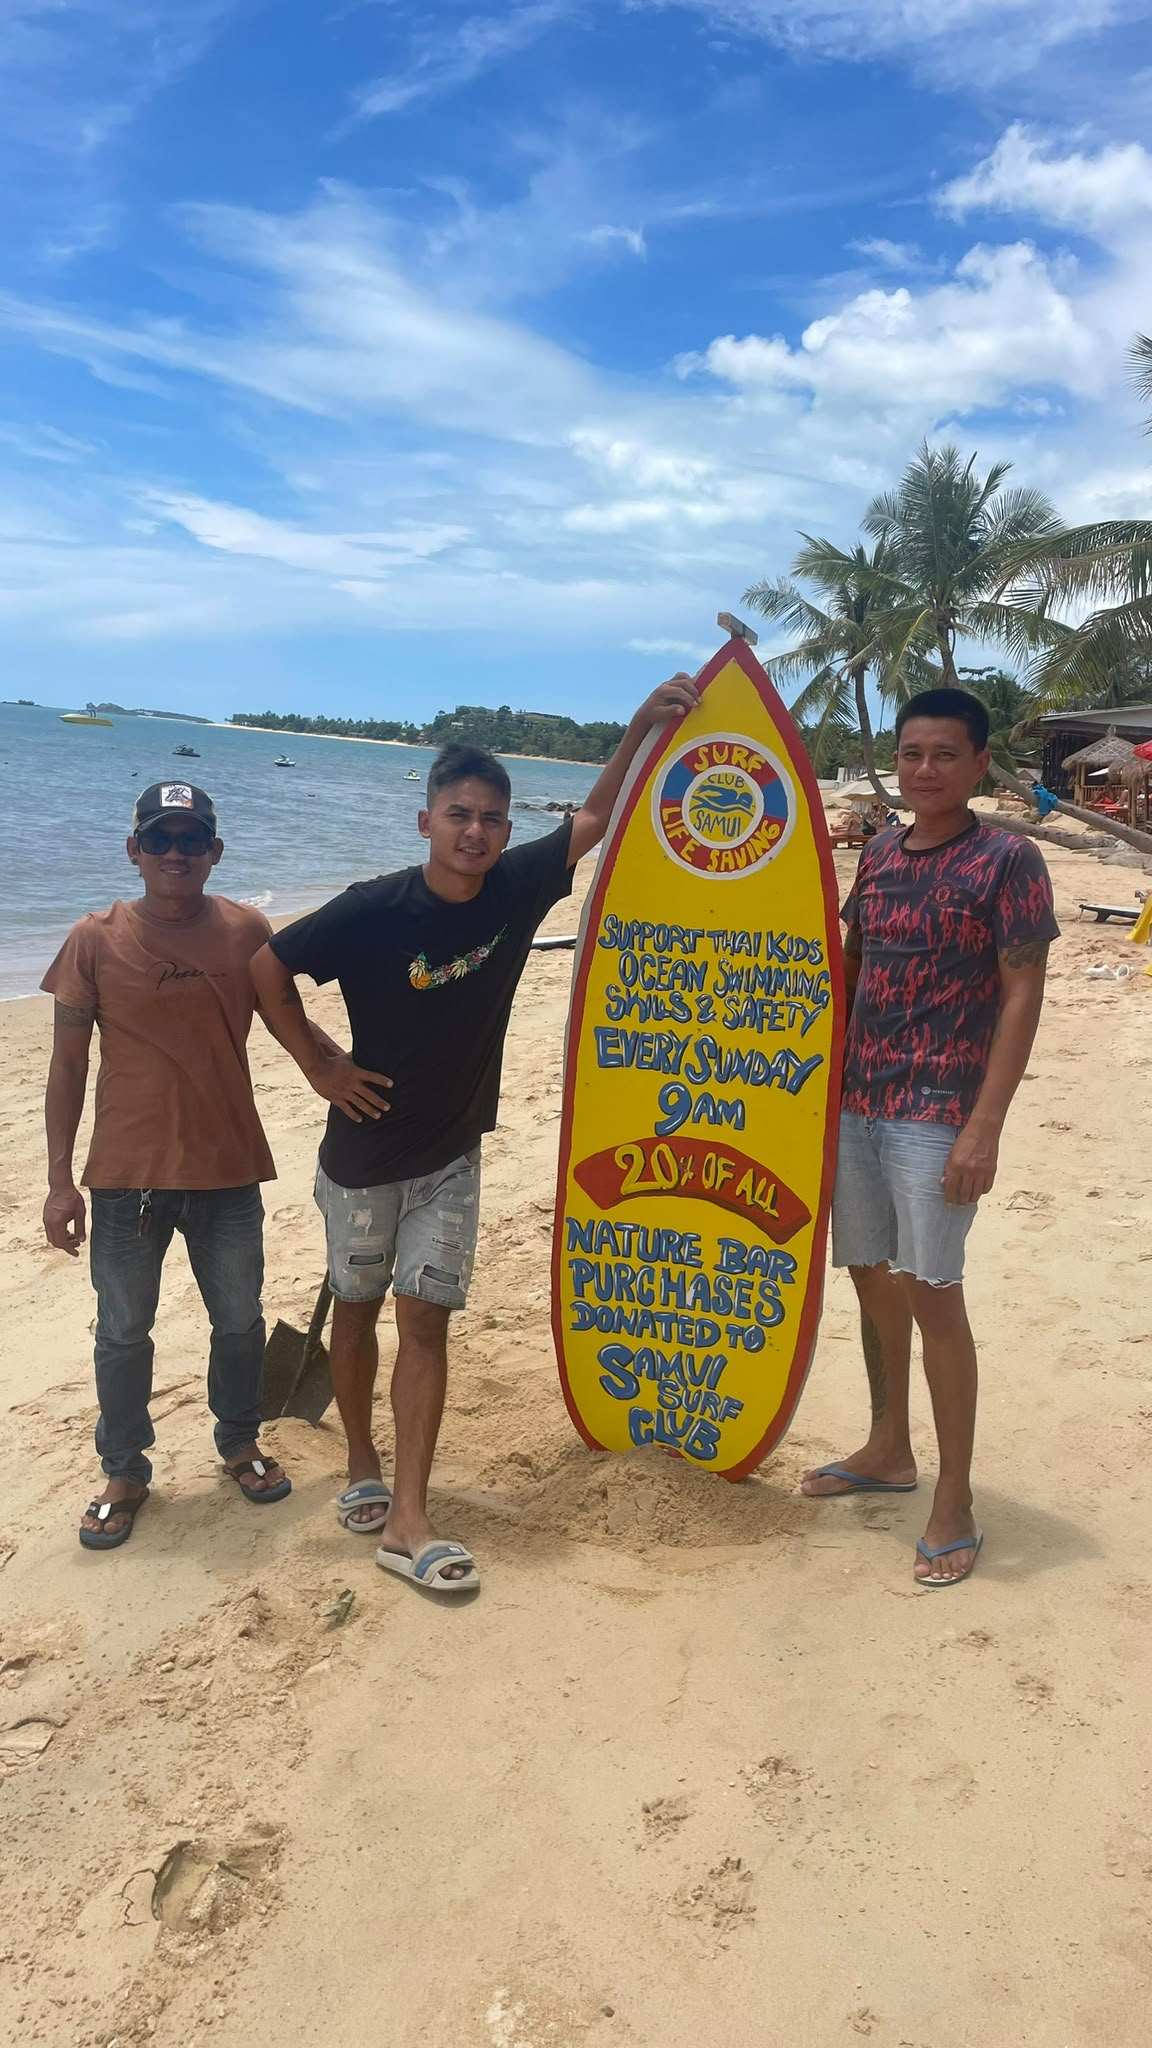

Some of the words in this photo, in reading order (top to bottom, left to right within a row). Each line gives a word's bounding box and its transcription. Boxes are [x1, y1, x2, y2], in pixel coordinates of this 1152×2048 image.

[694, 744, 766, 772] SURF
[708, 773, 745, 787] CLUB
[662, 806, 700, 862] LIFE
[707, 820, 780, 872] SAVING
[694, 810, 741, 837] SAMUI
[598, 914, 704, 954] SUPPORT
[707, 929, 761, 957] THAI
[767, 930, 824, 965] KIDS
[619, 950, 708, 991] OCEAN
[713, 958, 831, 1009] SWIMMING
[696, 994, 716, 1024] &
[723, 995, 823, 1038] SAFETY
[594, 1026, 693, 1075] EVERY
[685, 1034, 824, 1095] SUNDAY
[615, 1143, 695, 1195] 20%
[702, 1152, 735, 1190] OF
[736, 1168, 780, 1218] ALL
[566, 1216, 703, 1268] NATURE
[713, 1238, 797, 1284] BAR
[568, 1258, 785, 1327] PURCHASES
[570, 1300, 721, 1348] DONATED
[725, 1323, 766, 1352] TO
[597, 1343, 728, 1400] SAMUI
[657, 1379, 744, 1423] SURF
[628, 1406, 721, 1461] CLUB
